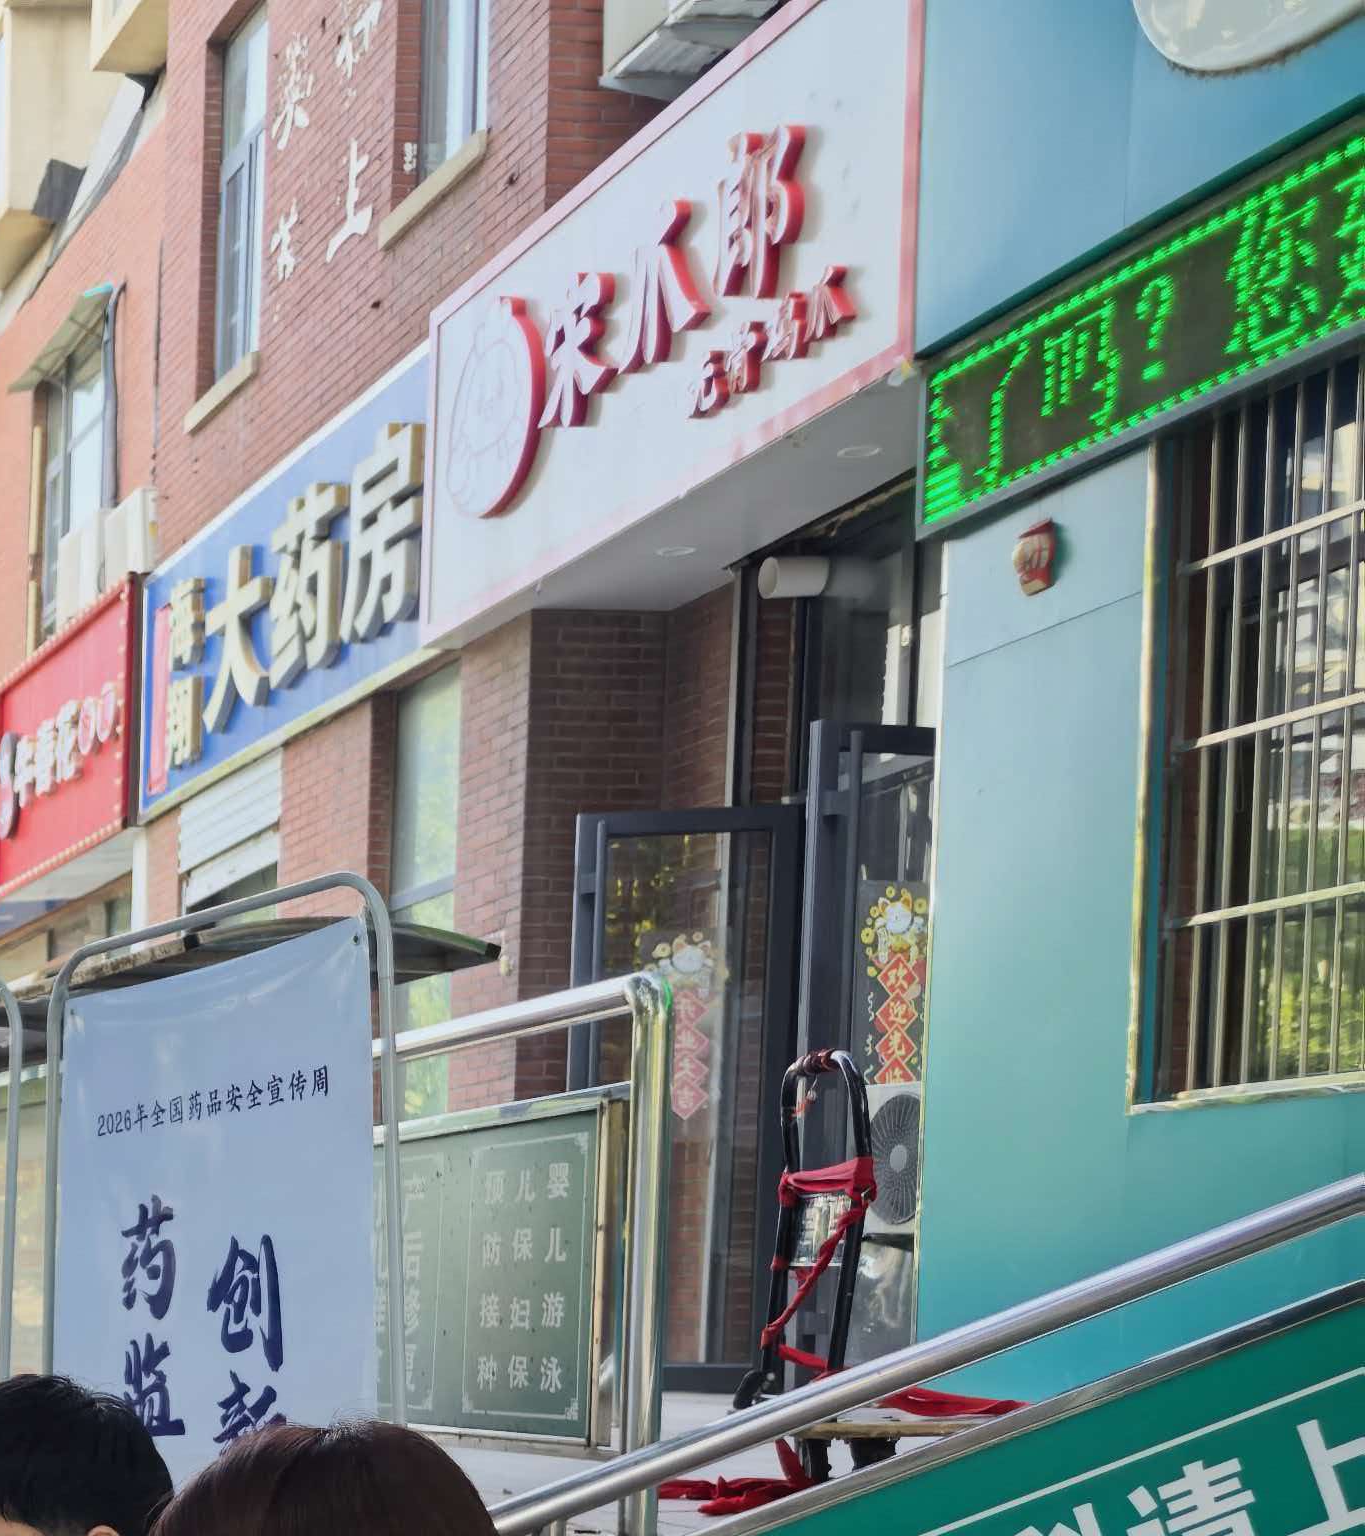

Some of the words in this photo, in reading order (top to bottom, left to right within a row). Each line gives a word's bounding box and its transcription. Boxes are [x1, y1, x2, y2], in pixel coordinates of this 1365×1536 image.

[96, 1064, 330, 1138] 2026年全国药品安全宣传周
[507, 1168, 536, 1390] 儿保妇保
[539, 1161, 571, 1394] 婴儿游泳
